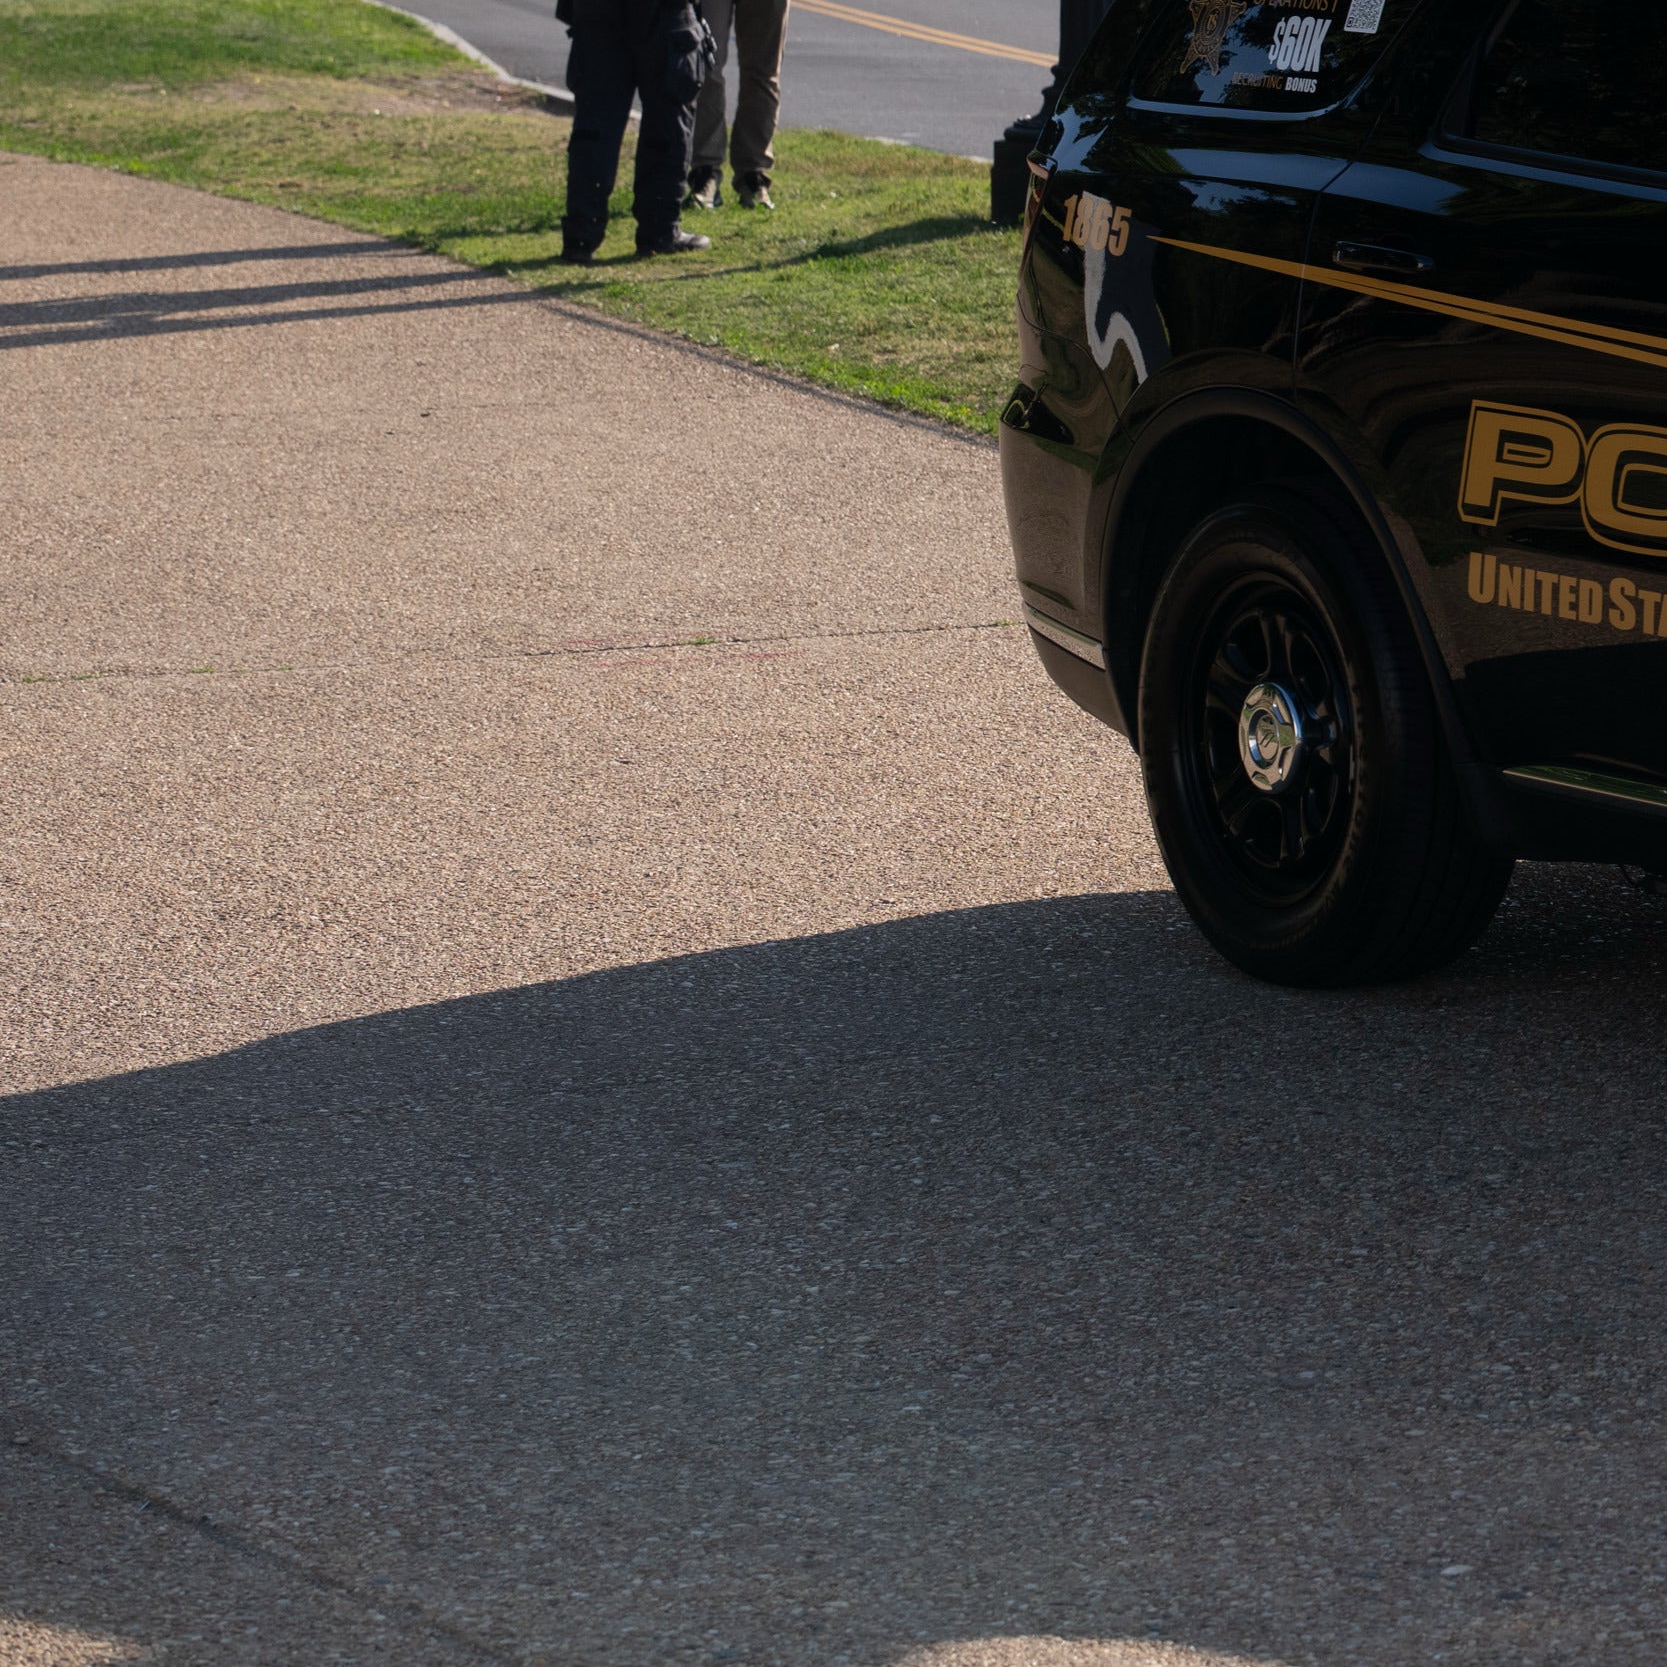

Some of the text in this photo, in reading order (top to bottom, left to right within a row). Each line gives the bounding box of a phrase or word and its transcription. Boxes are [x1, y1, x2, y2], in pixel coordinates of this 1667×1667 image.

[1268, 15, 1332, 73] $60K
[1231, 72, 1318, 94] RECRUITING BONUS
[1062, 194, 1132, 257] 1865
[1467, 551, 1602, 626] UNITED
